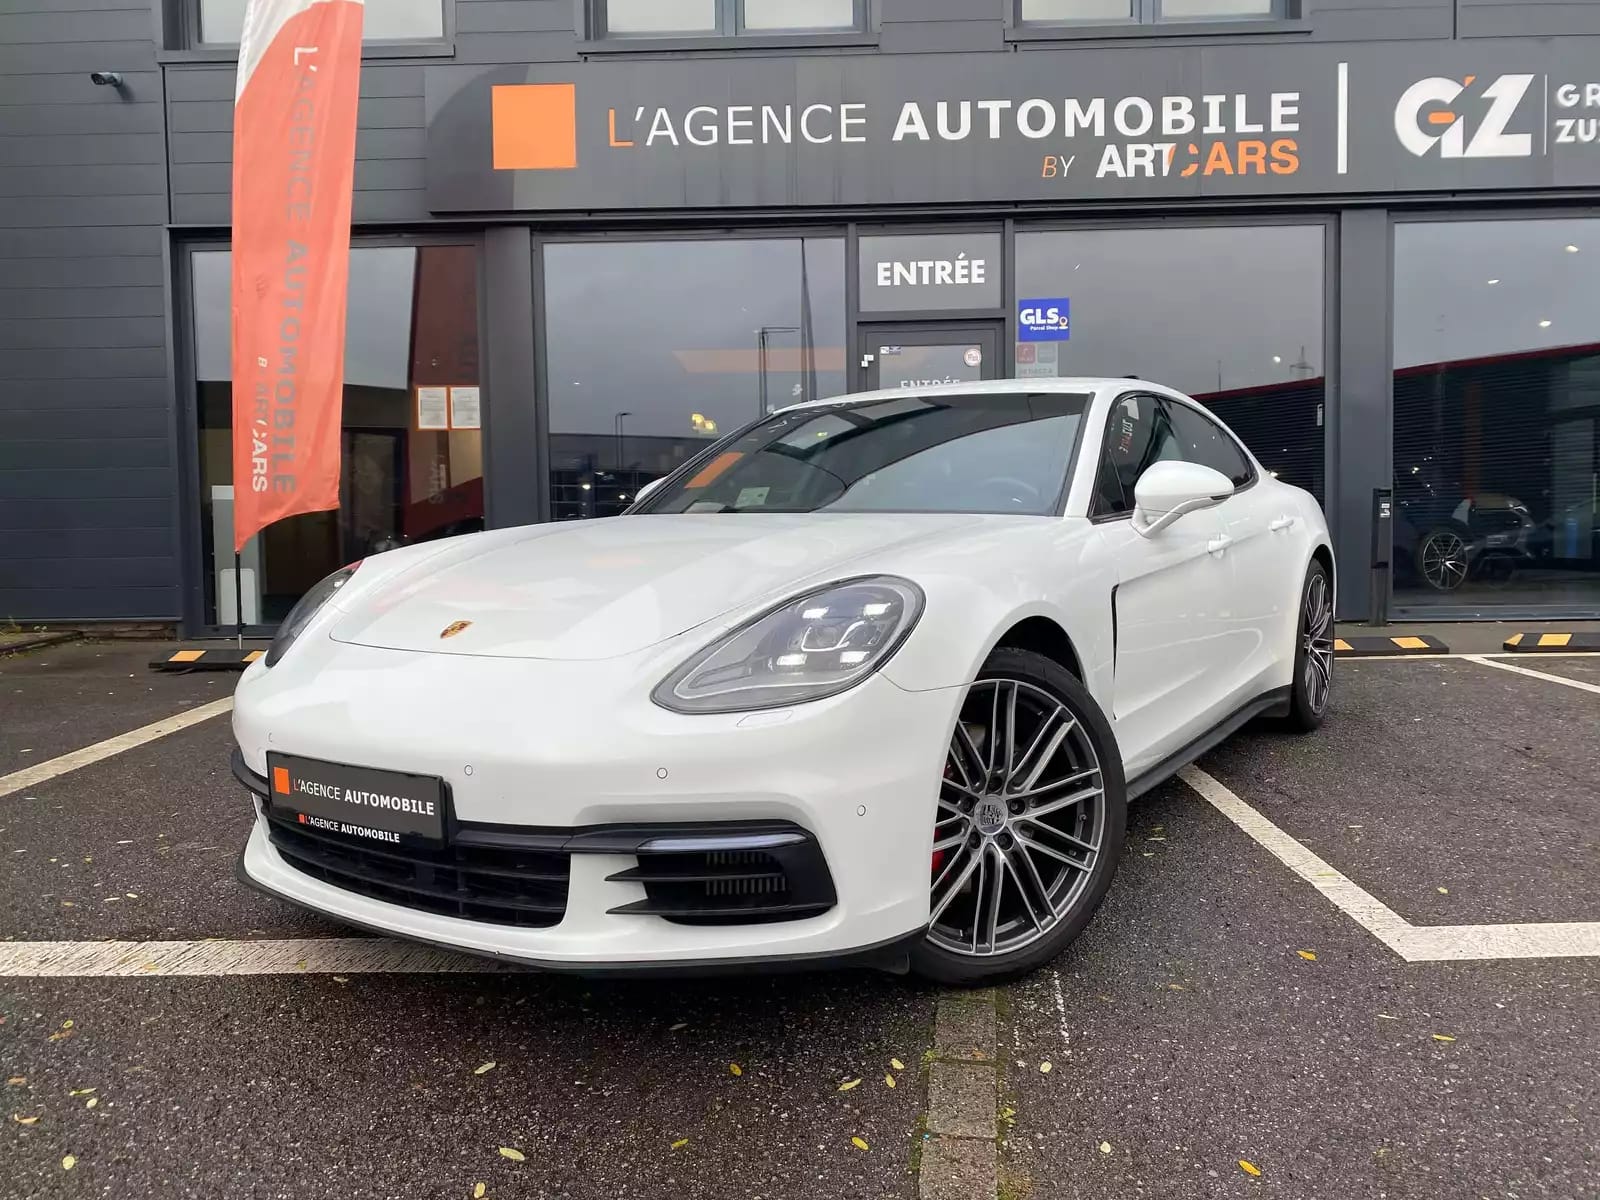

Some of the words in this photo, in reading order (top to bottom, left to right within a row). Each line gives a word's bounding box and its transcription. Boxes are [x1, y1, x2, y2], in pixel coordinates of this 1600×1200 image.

[608, 103, 866, 147] L'AGENCE
[892, 92, 1300, 142] AUTOMOBILE
[1556, 118, 1600, 143] ZU
[1042, 155, 1075, 178] BY
[1096, 138, 1300, 178] ARTCARS
[877, 252, 985, 286] ENTRÉE
[1020, 307, 1059, 325] GLS
[271, 243, 306, 494] AUTOMOBILE
[293, 777, 341, 801] L'AGENCE
[344, 789, 435, 816] AUTOMOBILE
[305, 815, 339, 832] L'AGENCE
[341, 824, 400, 843] AUTOMOBILE
